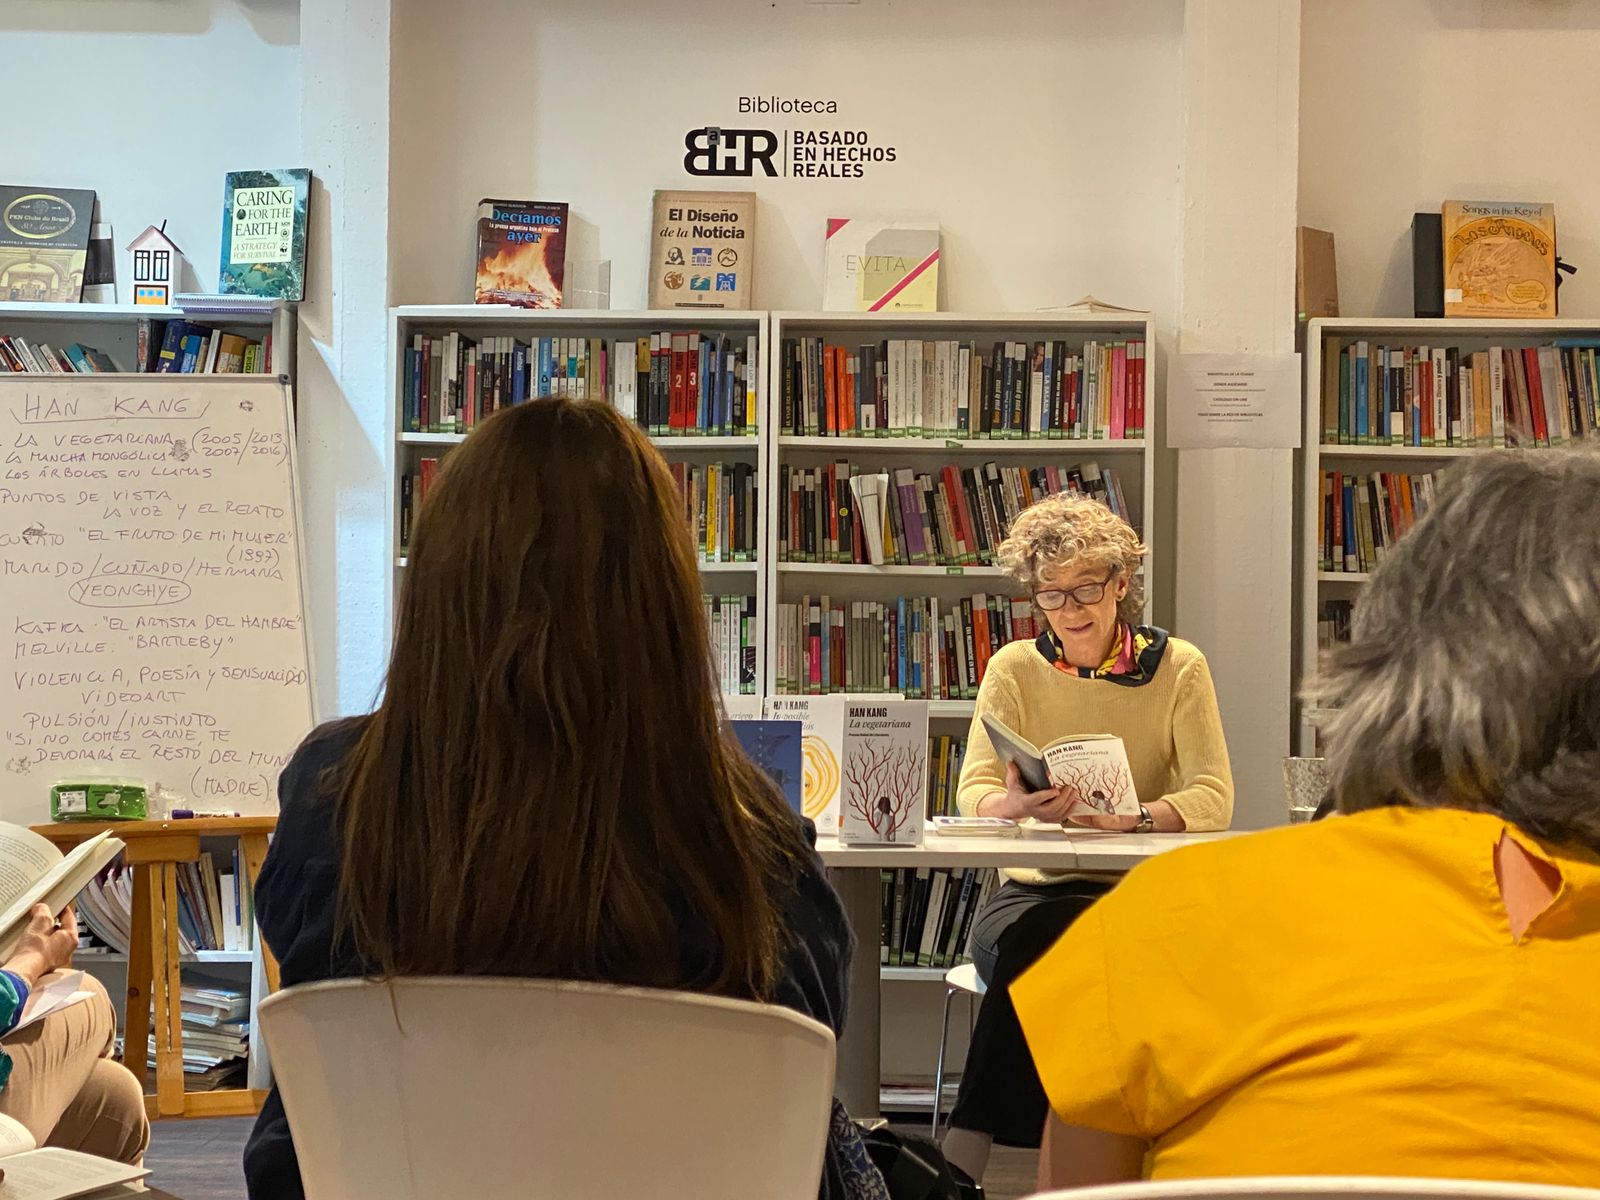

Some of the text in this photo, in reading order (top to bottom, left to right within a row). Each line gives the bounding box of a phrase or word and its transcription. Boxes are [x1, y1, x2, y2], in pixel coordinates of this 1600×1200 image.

[738, 96, 837, 113] Biblioteca
[793, 131, 868, 145] BASADO
[793, 147, 897, 162] EN HECHOS
[793, 164, 864, 178] REALES
[236, 190, 293, 207] CARING
[248, 208, 291, 219] FOR THE
[492, 209, 562, 226] Decíamos
[669, 208, 739, 222] El Diseño
[1462, 204, 1491, 215] Songs
[1501, 207, 1513, 215] the
[1514, 207, 1533, 217] Key
[1534, 207, 1543, 216] of
[235, 222, 278, 236] EARTH
[660, 226, 745, 239] de la Noticia
[1453, 226, 1489, 245] Los
[507, 231, 543, 245] ayer
[234, 242, 278, 251] A STRATEGY
[247, 251, 277, 259] SURVIVAL
[846, 254, 907, 272] EVITA
[675, 374, 682, 388] 2
[690, 372, 696, 386] 3
[25, 393, 191, 420] HAN KANG
[14, 432, 175, 448] LA VEGETARIANA
[5, 451, 22, 464] LA
[5, 465, 213, 480] LOS ÁRBOLES EN LLAMAS
[0, 488, 172, 505] PUNTOS DE VISTA
[103, 506, 122, 520] LA
[130, 506, 164, 517] VOZ
[198, 503, 220, 514] EL
[225, 500, 285, 519] RELATO
[114, 528, 175, 541] FRUTO
[181, 529, 204, 543] DE
[76, 581, 180, 605] YEONGHYE
[135, 616, 196, 629] ARTISTA
[204, 614, 236, 630] DEL
[139, 665, 201, 684] POESÍA
[81, 690, 187, 707] VIDEOART
[790, 701, 809, 710] KANG
[849, 707, 888, 718] HAN KANG
[849, 720, 911, 730] La vegetariana
[43, 734, 70, 745] NO
[209, 730, 231, 741] TE
[120, 749, 142, 760] EL
[208, 749, 241, 764] DEL
[247, 751, 293, 767] MUN
[1047, 744, 1084, 758] HAN KANG
